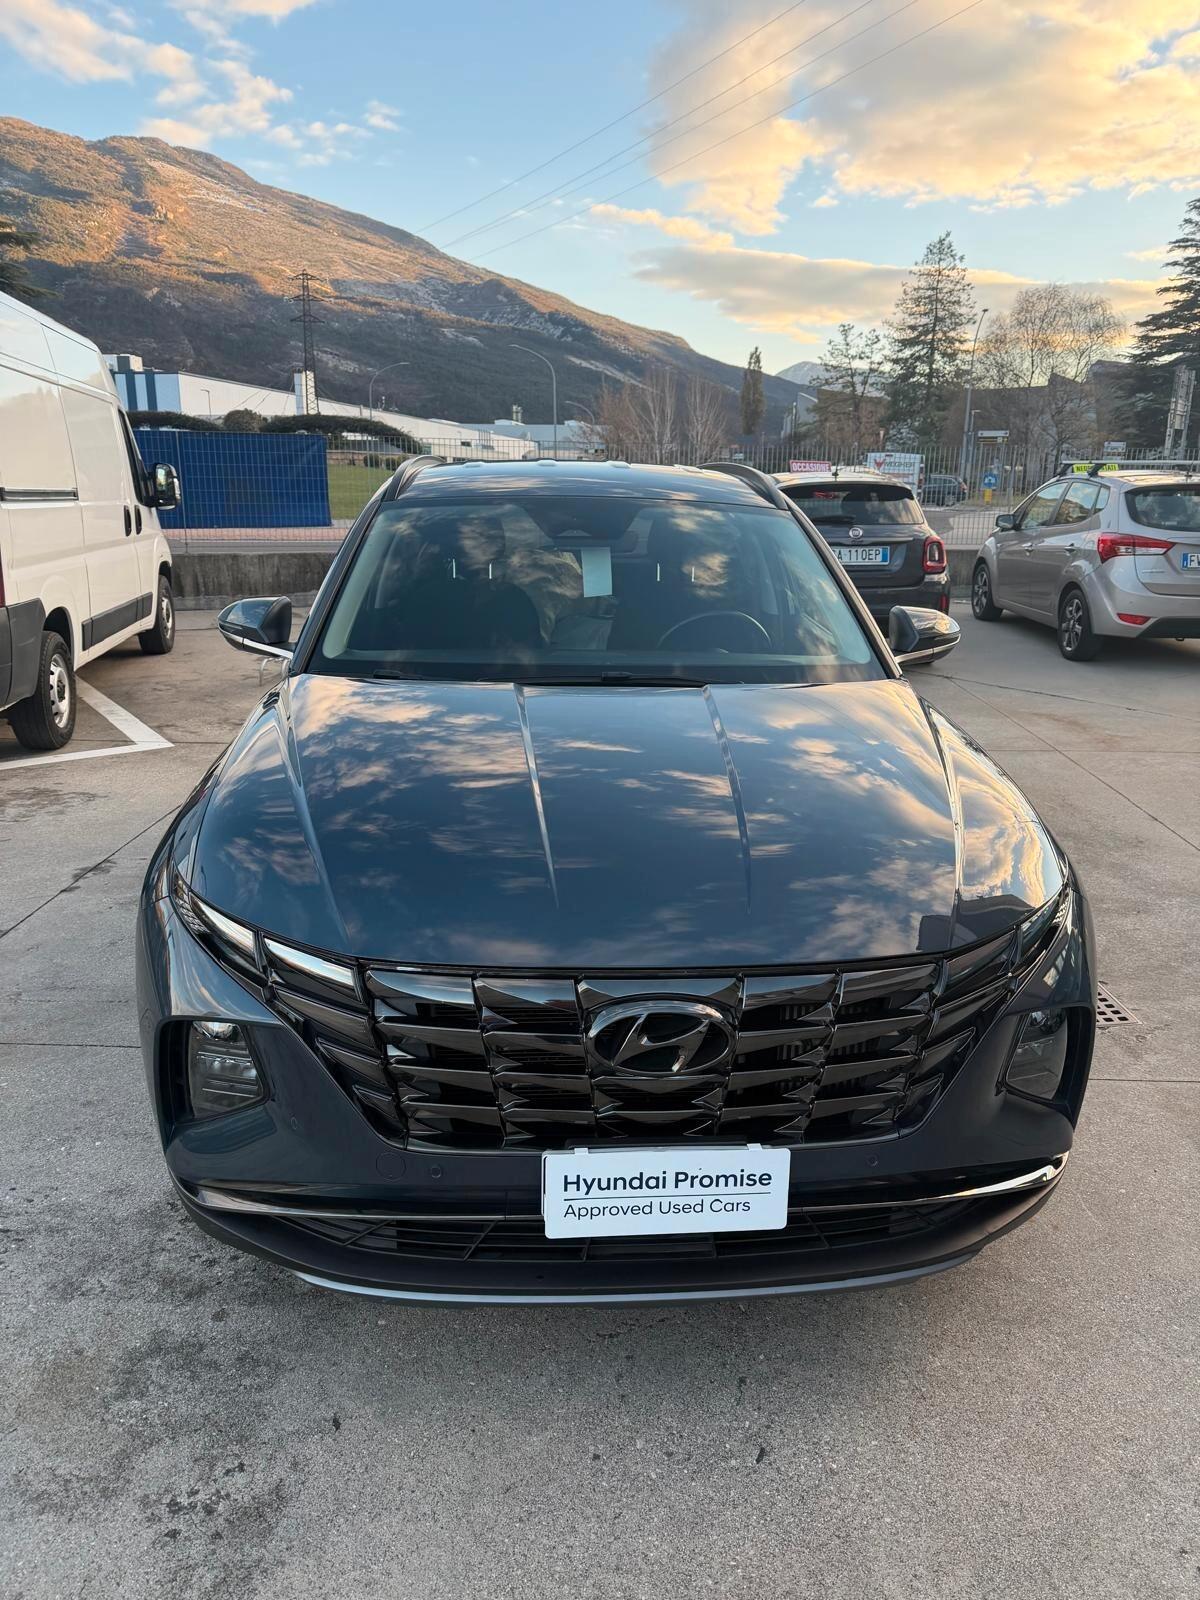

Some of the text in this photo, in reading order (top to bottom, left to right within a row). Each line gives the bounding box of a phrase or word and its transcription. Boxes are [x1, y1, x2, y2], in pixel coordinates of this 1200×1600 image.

[792, 462, 830, 472] OCCASIONE
[564, 1169, 772, 1194] Hyundai Promise
[564, 1198, 751, 1220] Approved Used Cars
